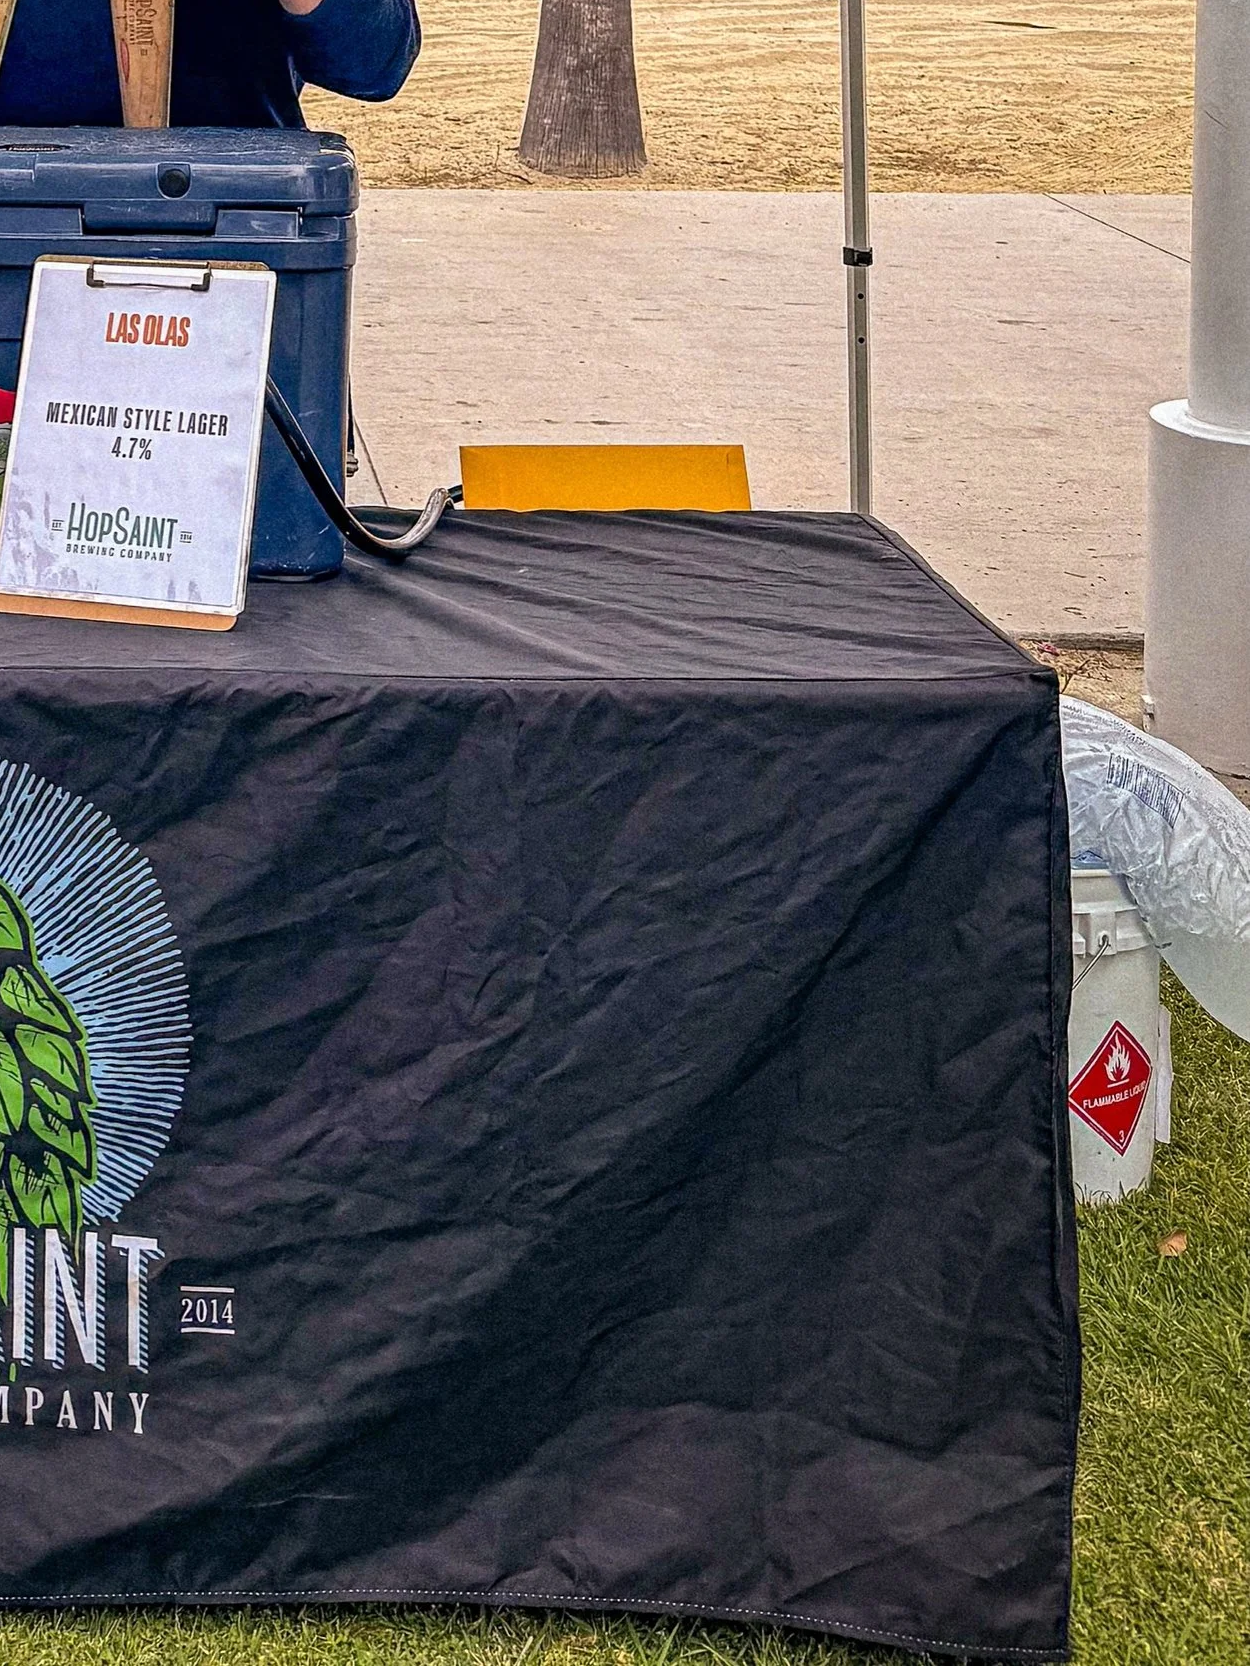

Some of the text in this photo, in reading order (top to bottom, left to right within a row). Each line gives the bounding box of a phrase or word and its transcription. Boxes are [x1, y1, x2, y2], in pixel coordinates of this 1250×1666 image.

[105, 312, 191, 347] LAS OLAS
[46, 402, 228, 436] MEXICAN STYLE LAGER
[111, 436, 152, 460] 4.7%
[65, 543, 172, 563] BREWING COMPANY
[1082, 1089, 1130, 1110] FLAMMABLE
[1118, 1129, 1126, 1144] 3
[181, 1298, 234, 1325] 2014
